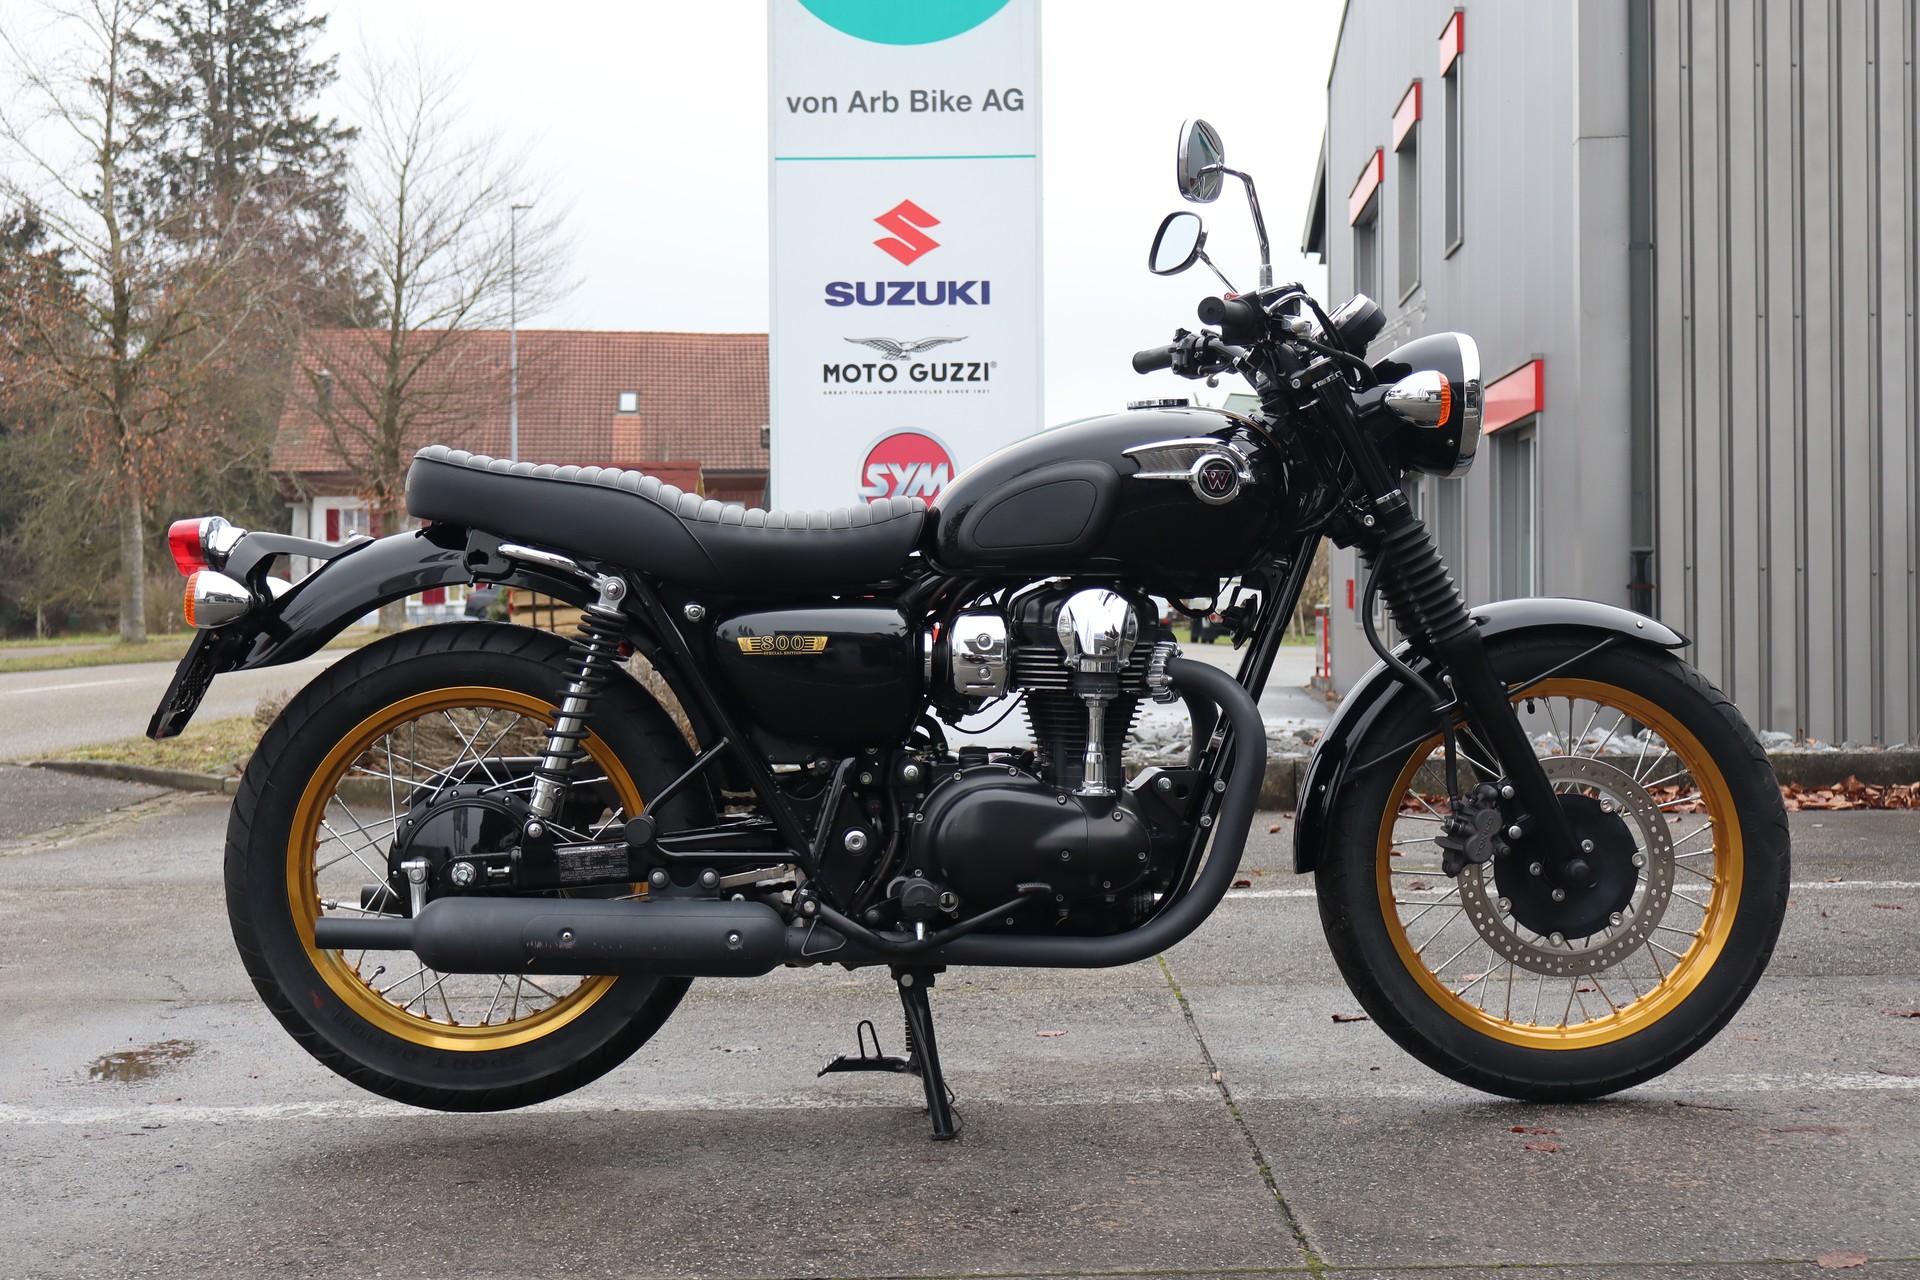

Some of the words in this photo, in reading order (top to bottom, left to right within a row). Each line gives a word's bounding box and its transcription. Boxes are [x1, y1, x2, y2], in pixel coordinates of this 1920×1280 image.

[786, 96, 838, 113] von
[847, 90, 899, 113] Arb
[910, 89, 973, 112] Bike
[982, 88, 1025, 112] AG
[825, 281, 990, 307] SUZUKI
[823, 363, 898, 383] MOTO
[909, 362, 989, 382] GUZZI
[858, 462, 949, 497] SYM
[1203, 469, 1232, 490] W
[761, 635, 805, 651] 800
